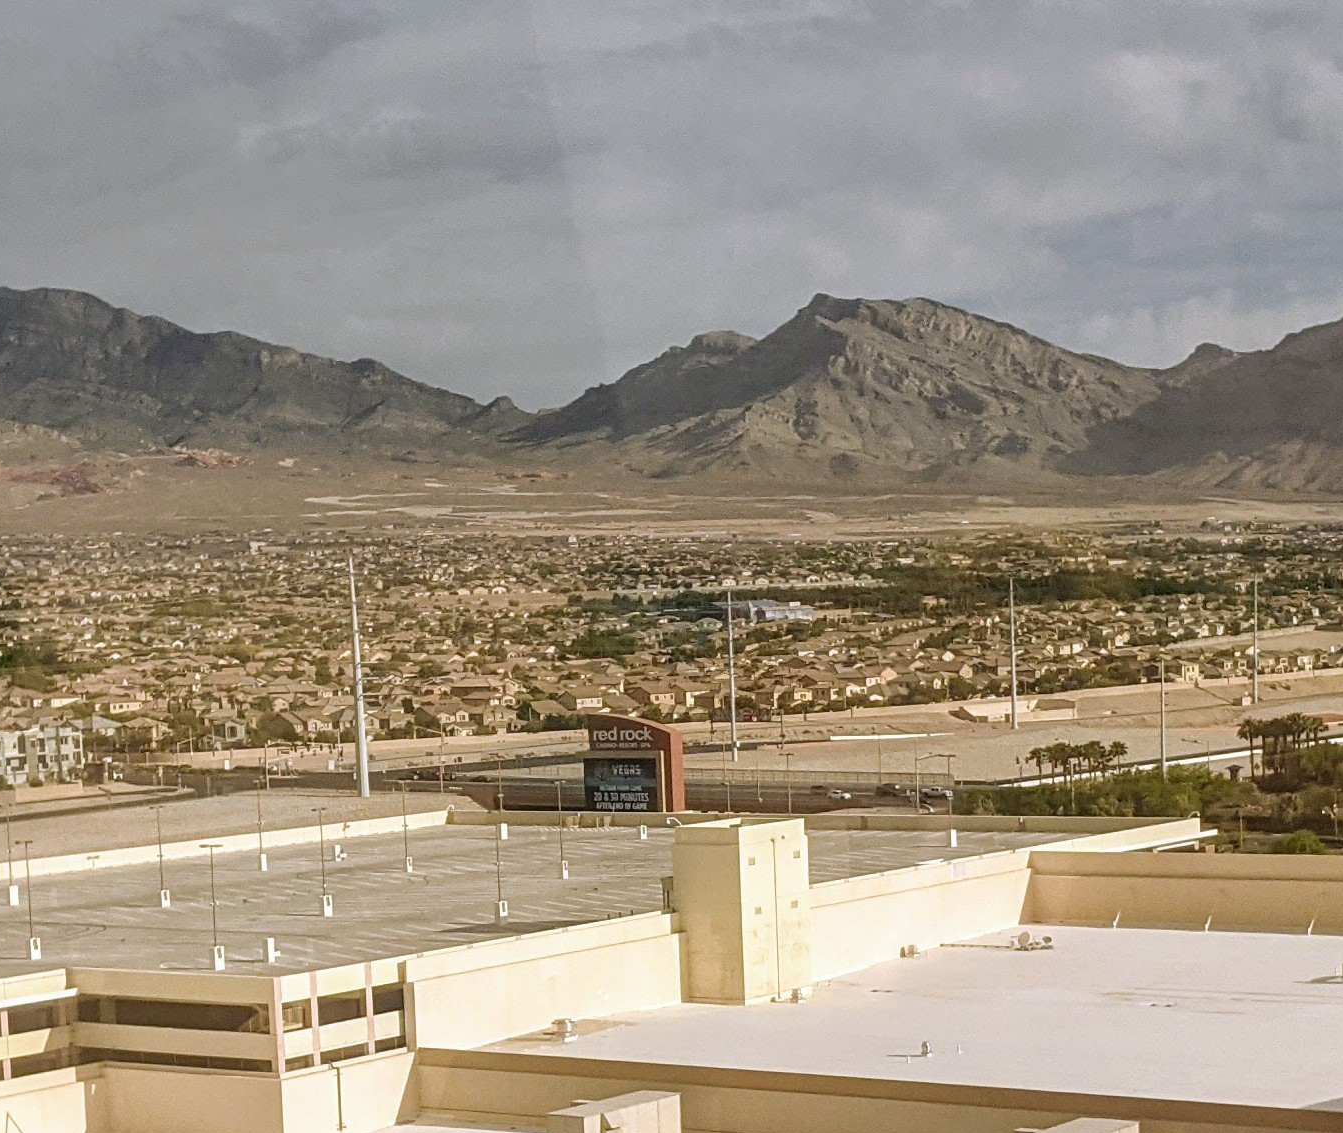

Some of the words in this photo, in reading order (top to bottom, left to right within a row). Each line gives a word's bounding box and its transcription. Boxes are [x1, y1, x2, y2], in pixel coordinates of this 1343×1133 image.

[593, 726, 617, 741] red
[620, 726, 653, 741] rock
[612, 764, 641, 775] VEGAS
[619, 793, 649, 801] MINUTES
